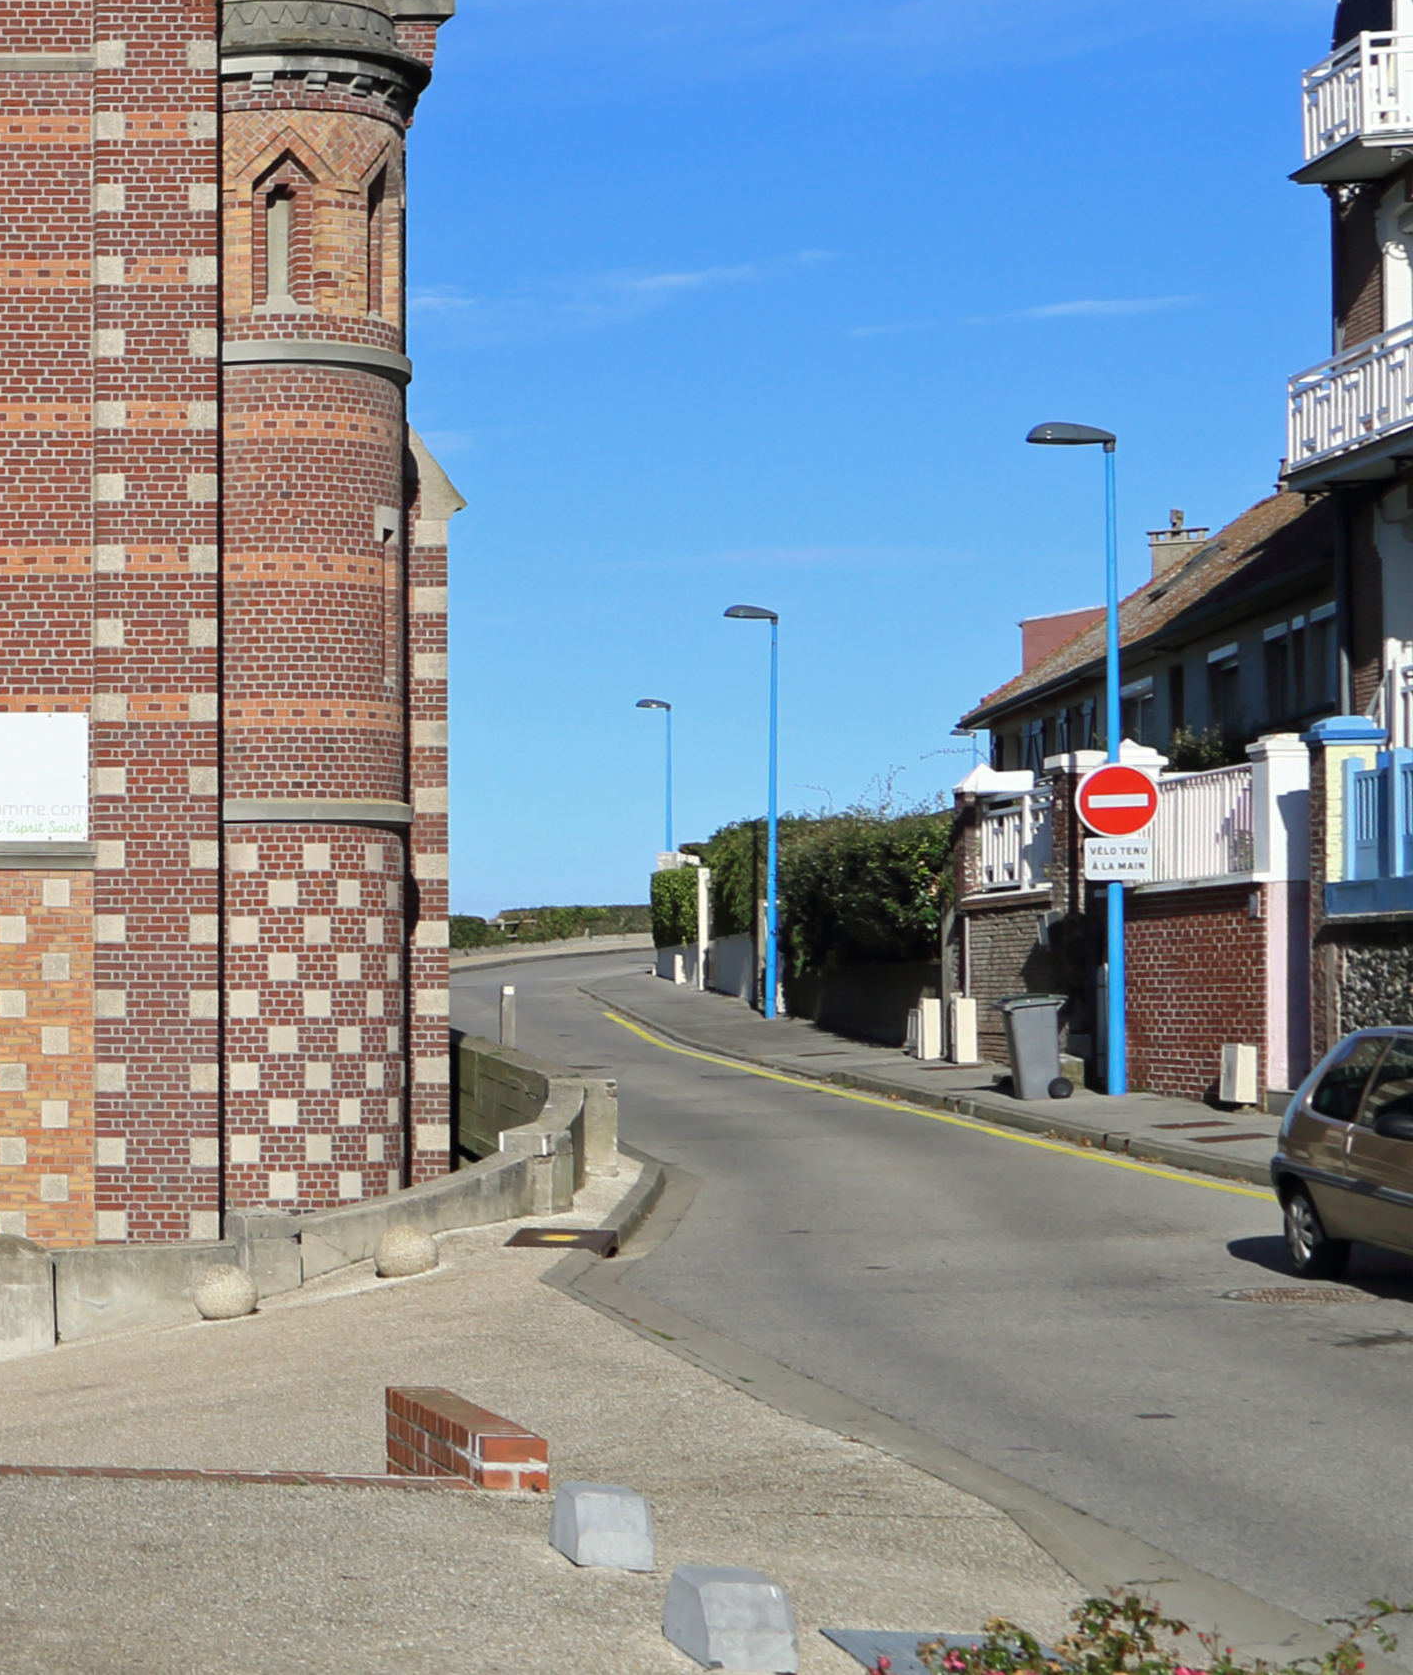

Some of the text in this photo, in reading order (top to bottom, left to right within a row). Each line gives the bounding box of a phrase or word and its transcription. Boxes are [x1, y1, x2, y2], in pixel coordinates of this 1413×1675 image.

[1120, 846, 1148, 856] TENU
[1102, 861, 1115, 870] LA
[1118, 861, 1145, 870] MAIN
